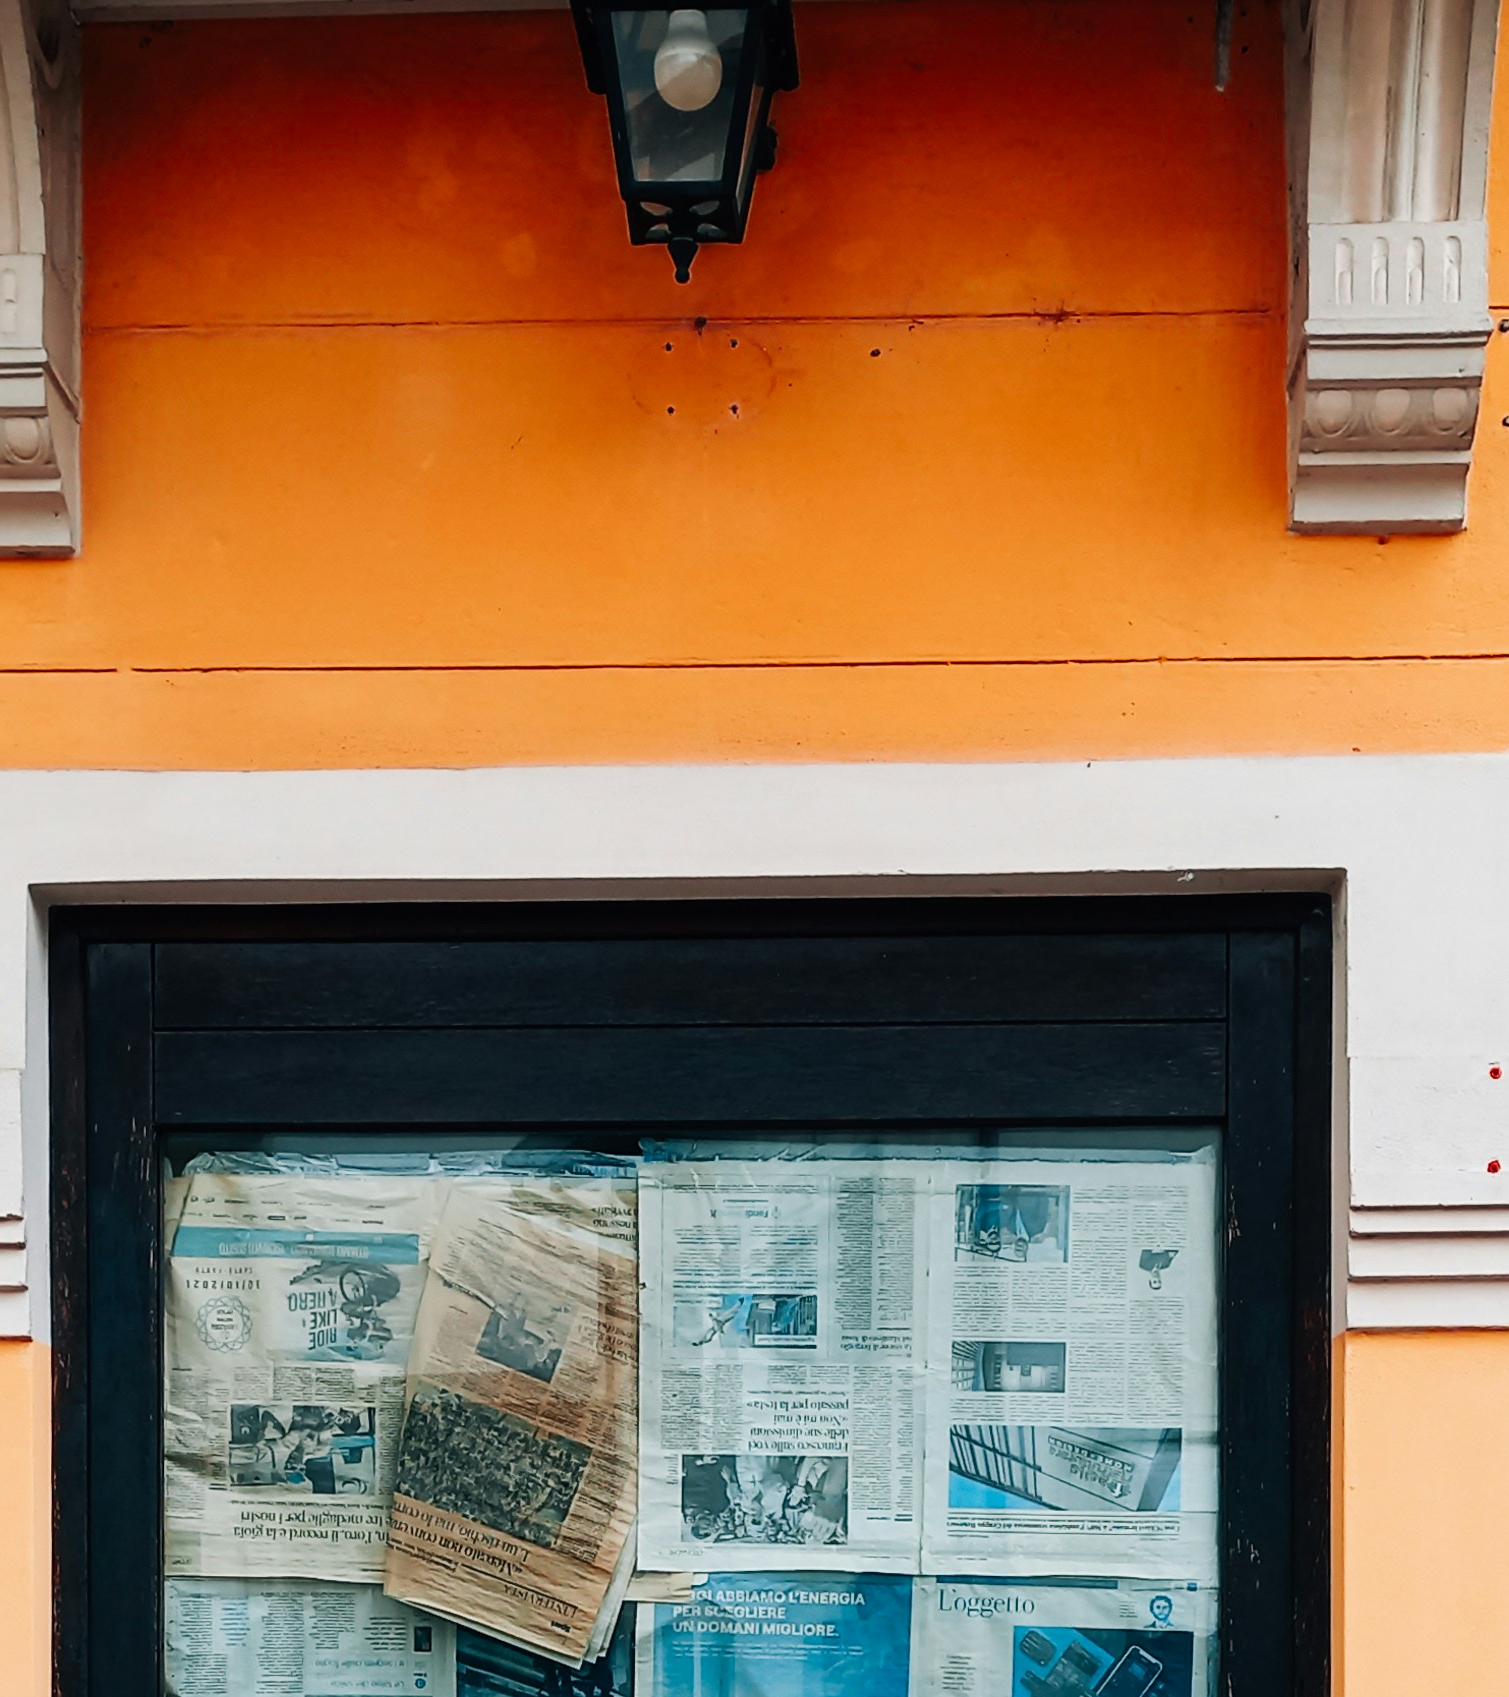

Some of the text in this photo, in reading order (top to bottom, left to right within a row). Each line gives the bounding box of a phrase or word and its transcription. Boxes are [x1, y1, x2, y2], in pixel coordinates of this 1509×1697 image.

[309, 1309, 338, 1328] LIKE
[308, 1326, 337, 1350] RIDE
[288, 1510, 307, 1525] per
[308, 1511, 362, 1525] medaglie
[288, 1524, 329, 1542] record
[716, 1591, 865, 1605] ABBIAMO L'ENERGIA
[937, 1589, 1035, 1617] L'oggetto
[673, 1605, 786, 1619] PER SCEGLIERE
[673, 1621, 839, 1637] UN DOMANI MIGLIORE.
